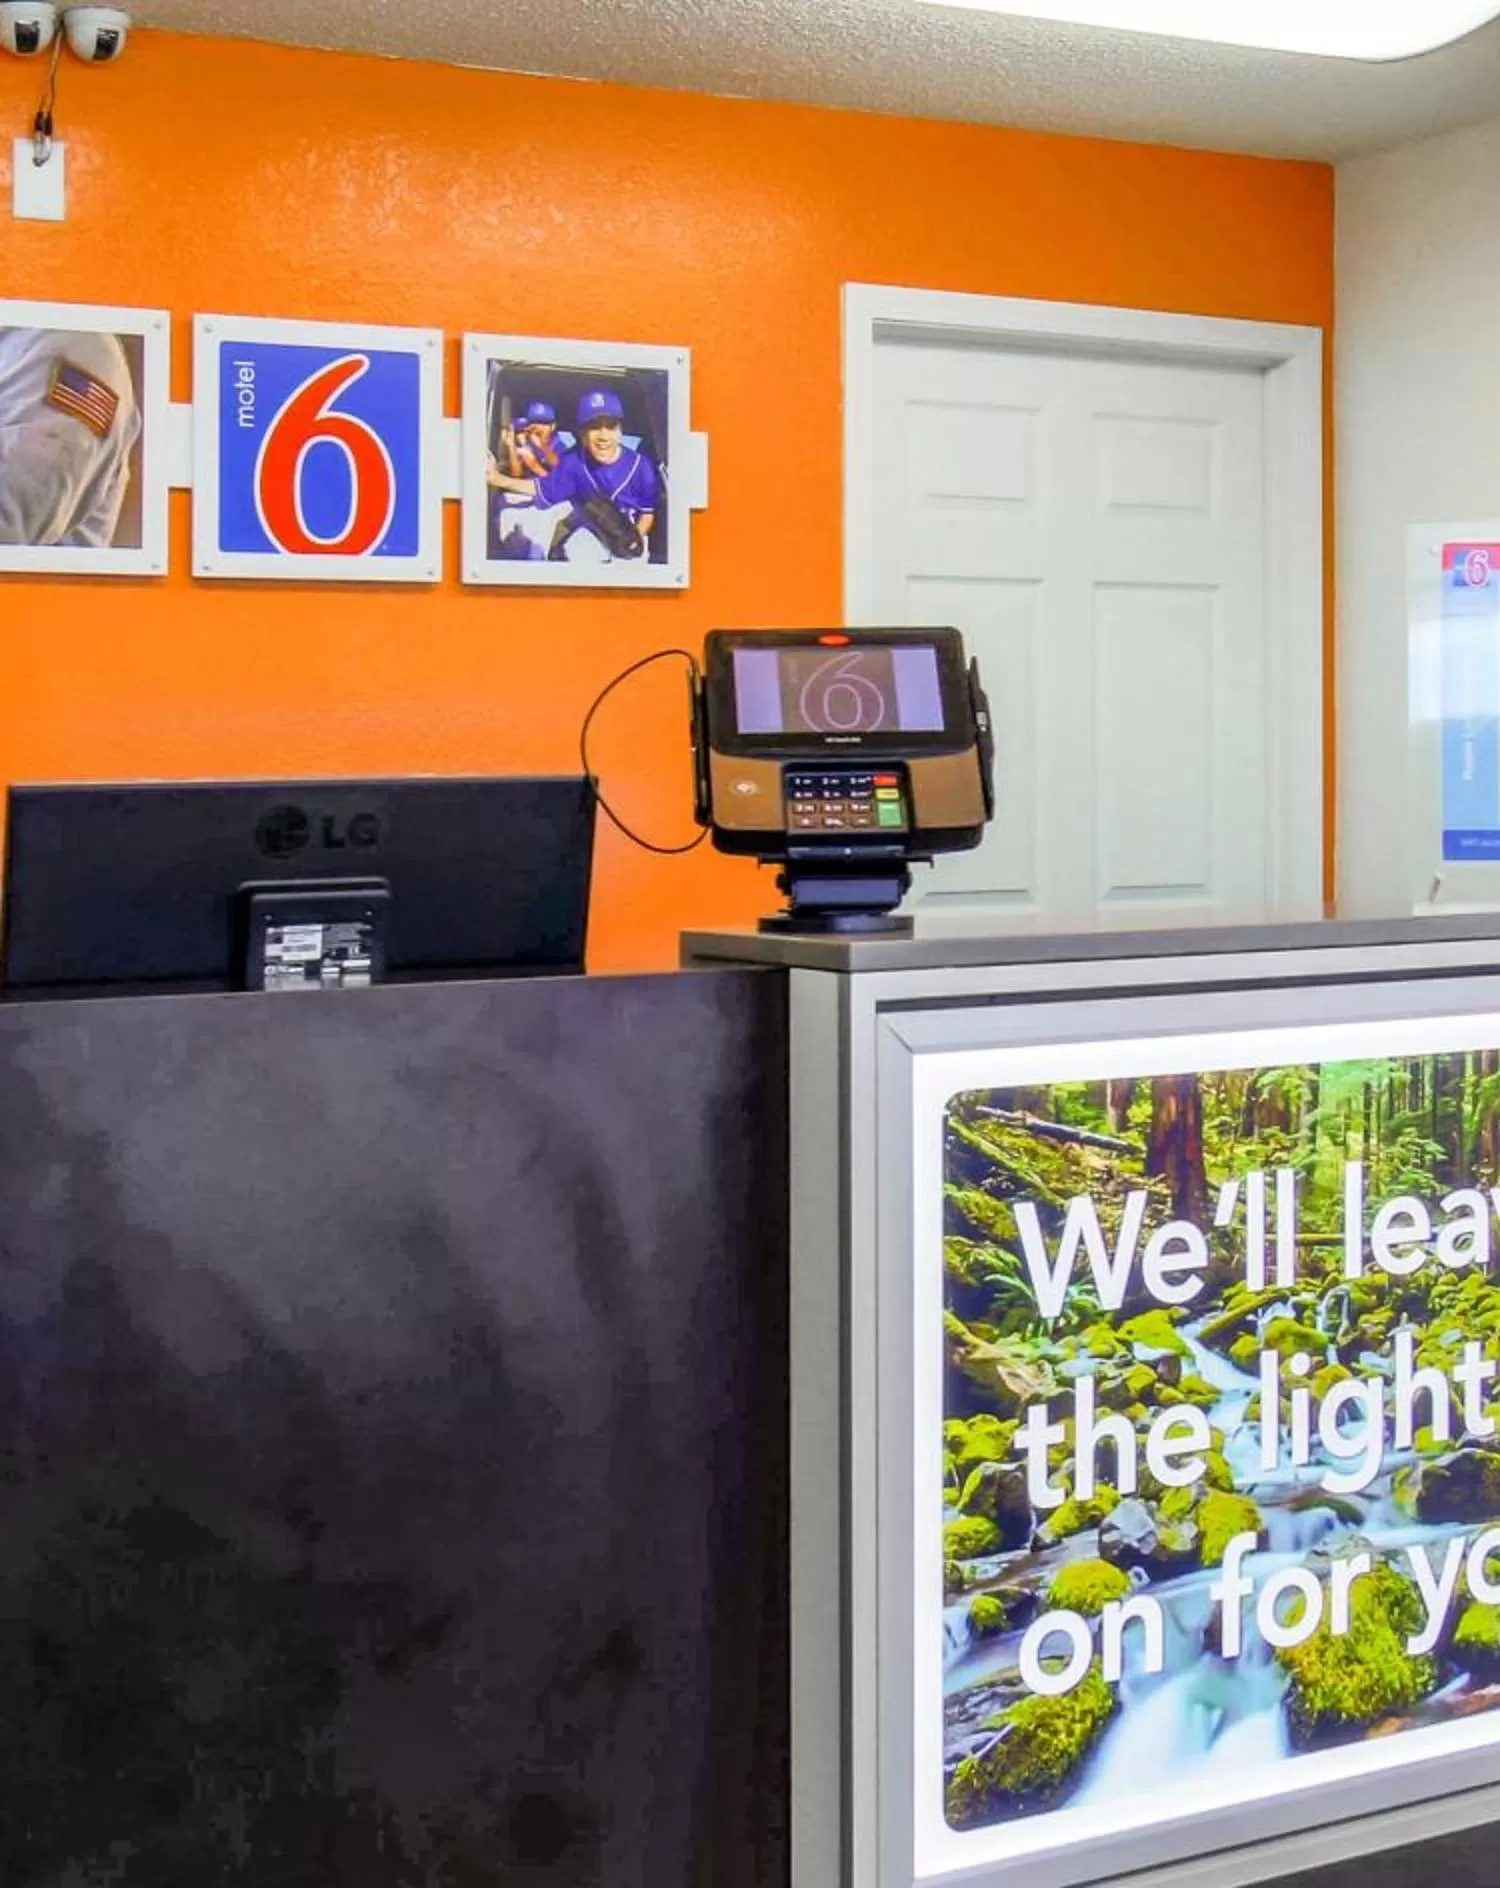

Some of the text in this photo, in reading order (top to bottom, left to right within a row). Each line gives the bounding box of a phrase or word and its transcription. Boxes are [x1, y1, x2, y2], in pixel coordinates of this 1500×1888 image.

[233, 353, 396, 557] motel 6
[801, 651, 885, 732] 6
[322, 811, 380, 849] LG
[1013, 1167, 1296, 1318] We'll
[1013, 1331, 1497, 1508] the light
[1018, 1592, 1165, 1695] on
[1210, 1531, 1372, 1658] for
